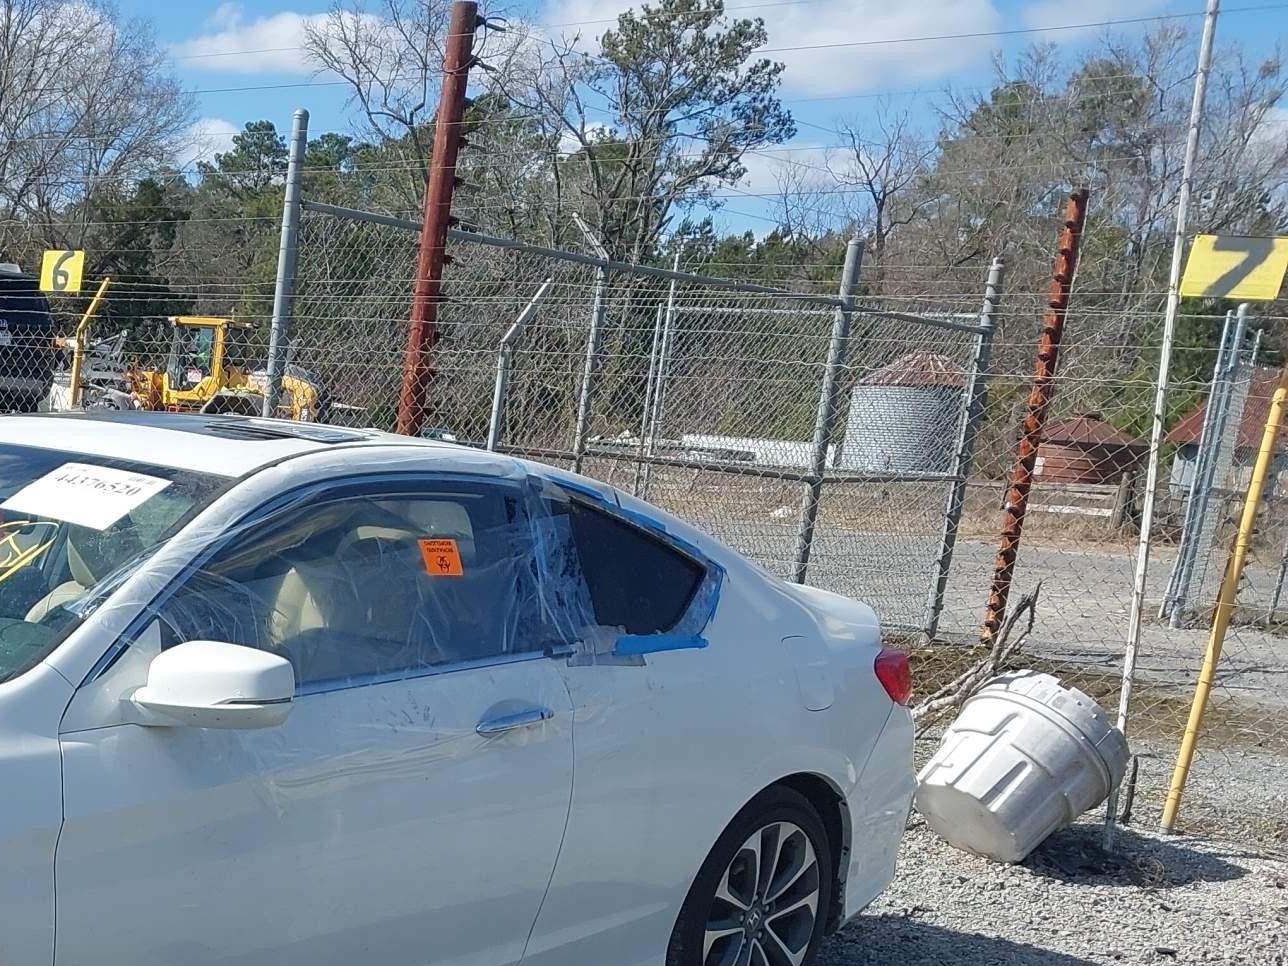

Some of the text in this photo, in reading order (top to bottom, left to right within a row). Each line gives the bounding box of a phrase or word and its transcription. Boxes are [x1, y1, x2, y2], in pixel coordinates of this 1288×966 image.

[52, 250, 75, 291] 6
[1201, 235, 1275, 297] 7
[55, 472, 142, 496] 44376520
